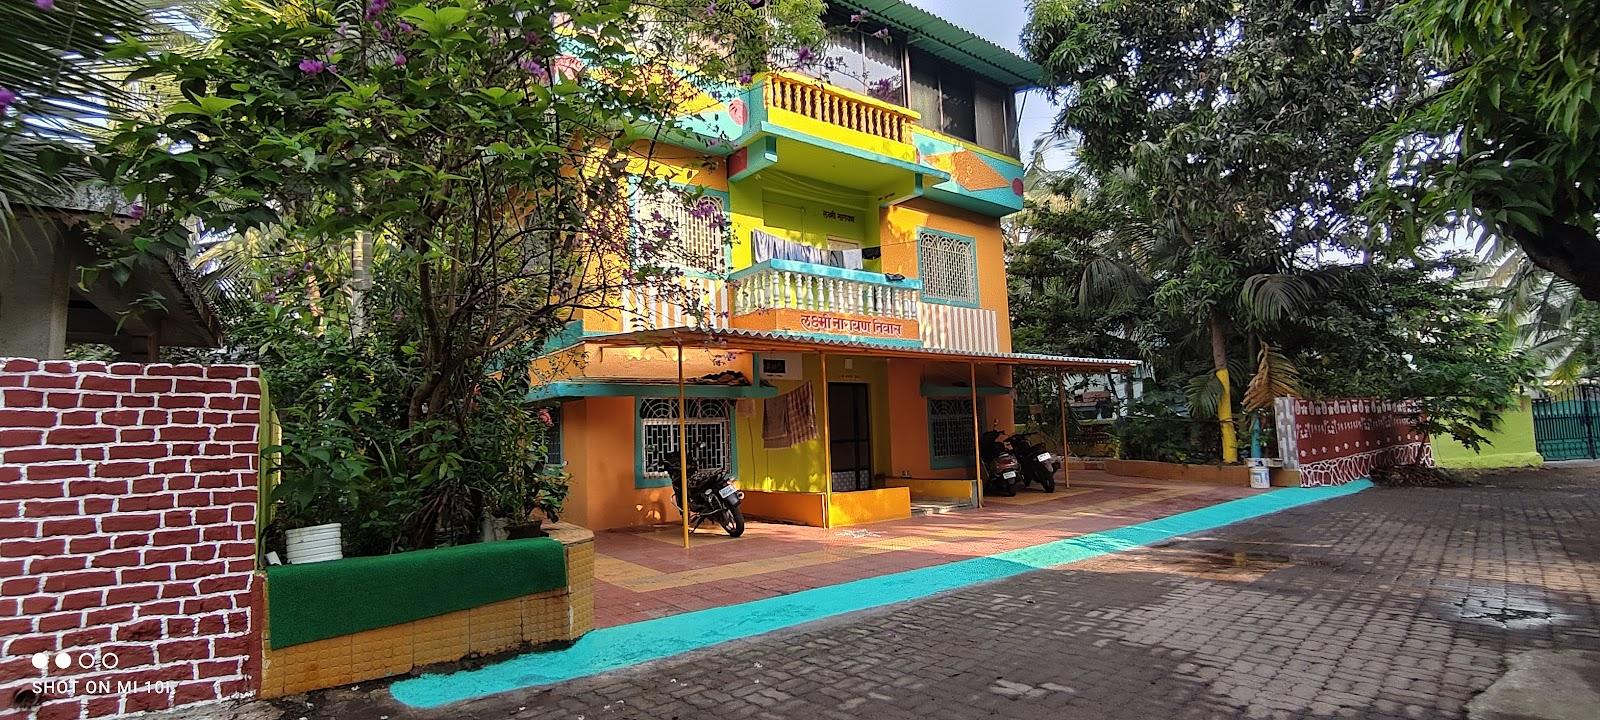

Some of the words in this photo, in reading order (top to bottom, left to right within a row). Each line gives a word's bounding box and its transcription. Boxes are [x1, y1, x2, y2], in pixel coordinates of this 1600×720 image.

[800, 313, 832, 331] लक्ष्मी
[832, 317, 872, 333] नारायण
[873, 319, 902, 336] निवास
